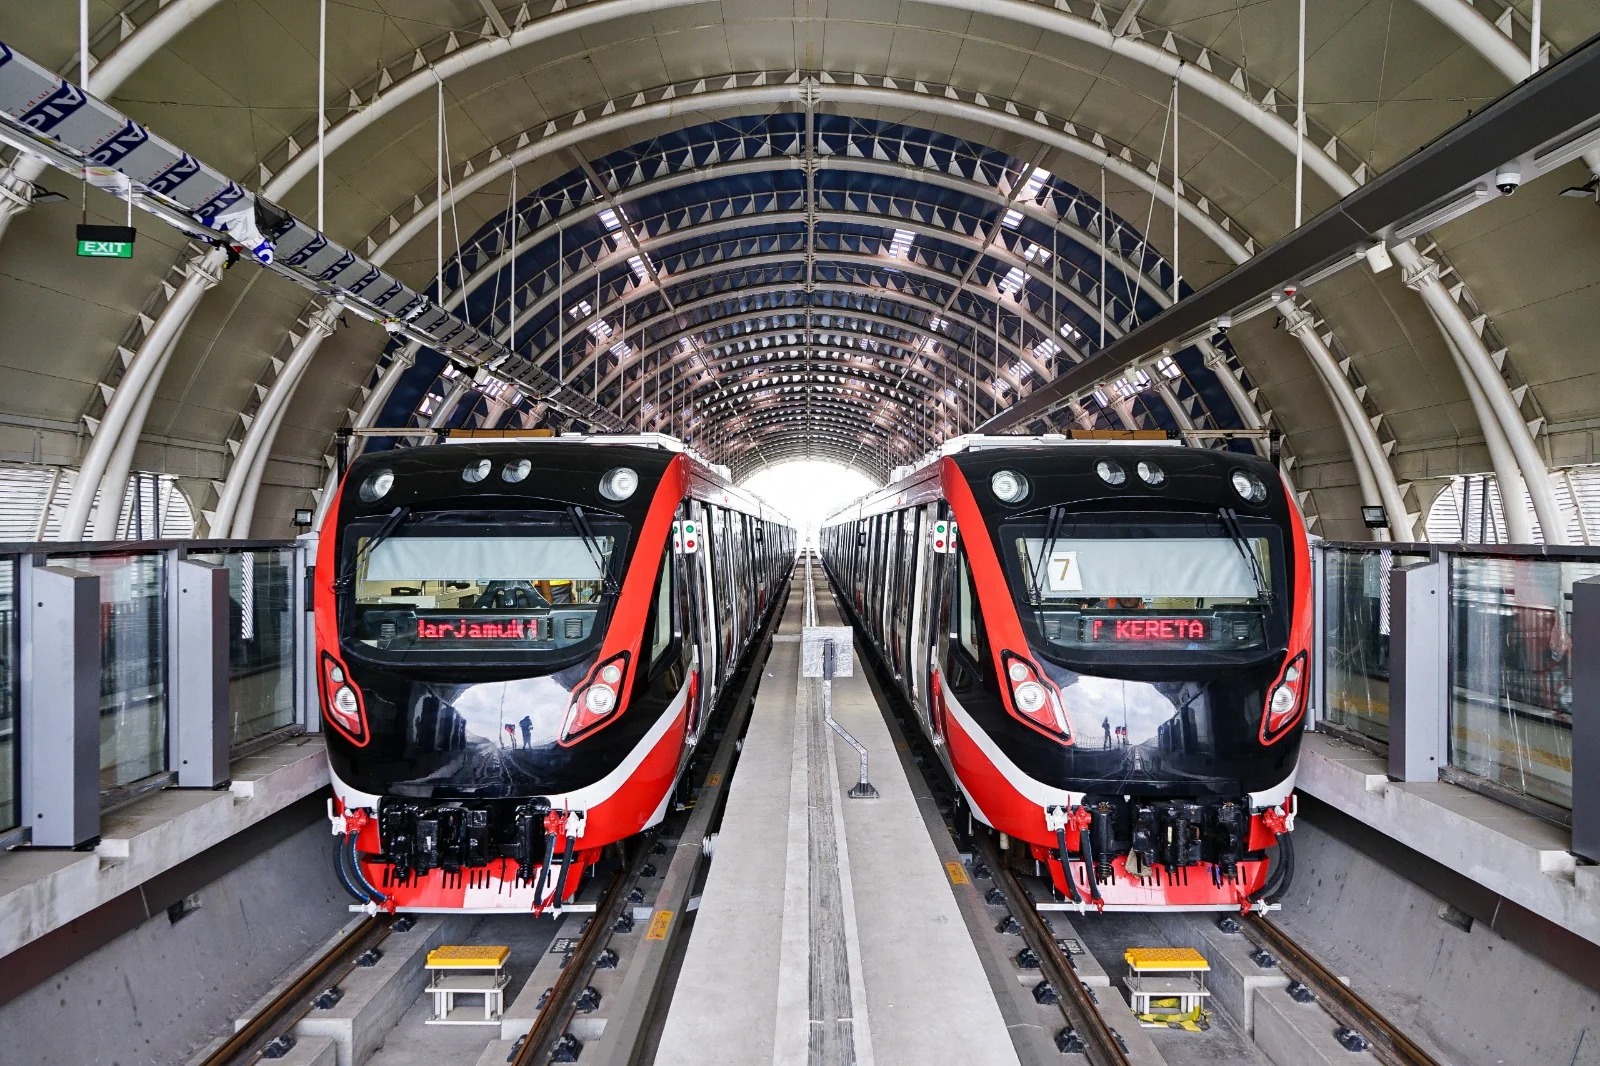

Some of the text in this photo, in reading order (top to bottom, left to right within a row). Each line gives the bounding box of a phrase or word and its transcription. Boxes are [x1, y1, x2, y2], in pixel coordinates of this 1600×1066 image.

[84, 241, 126, 253] EXIT
[1054, 559, 1070, 581] 7
[1116, 620, 1204, 638] KERETA
